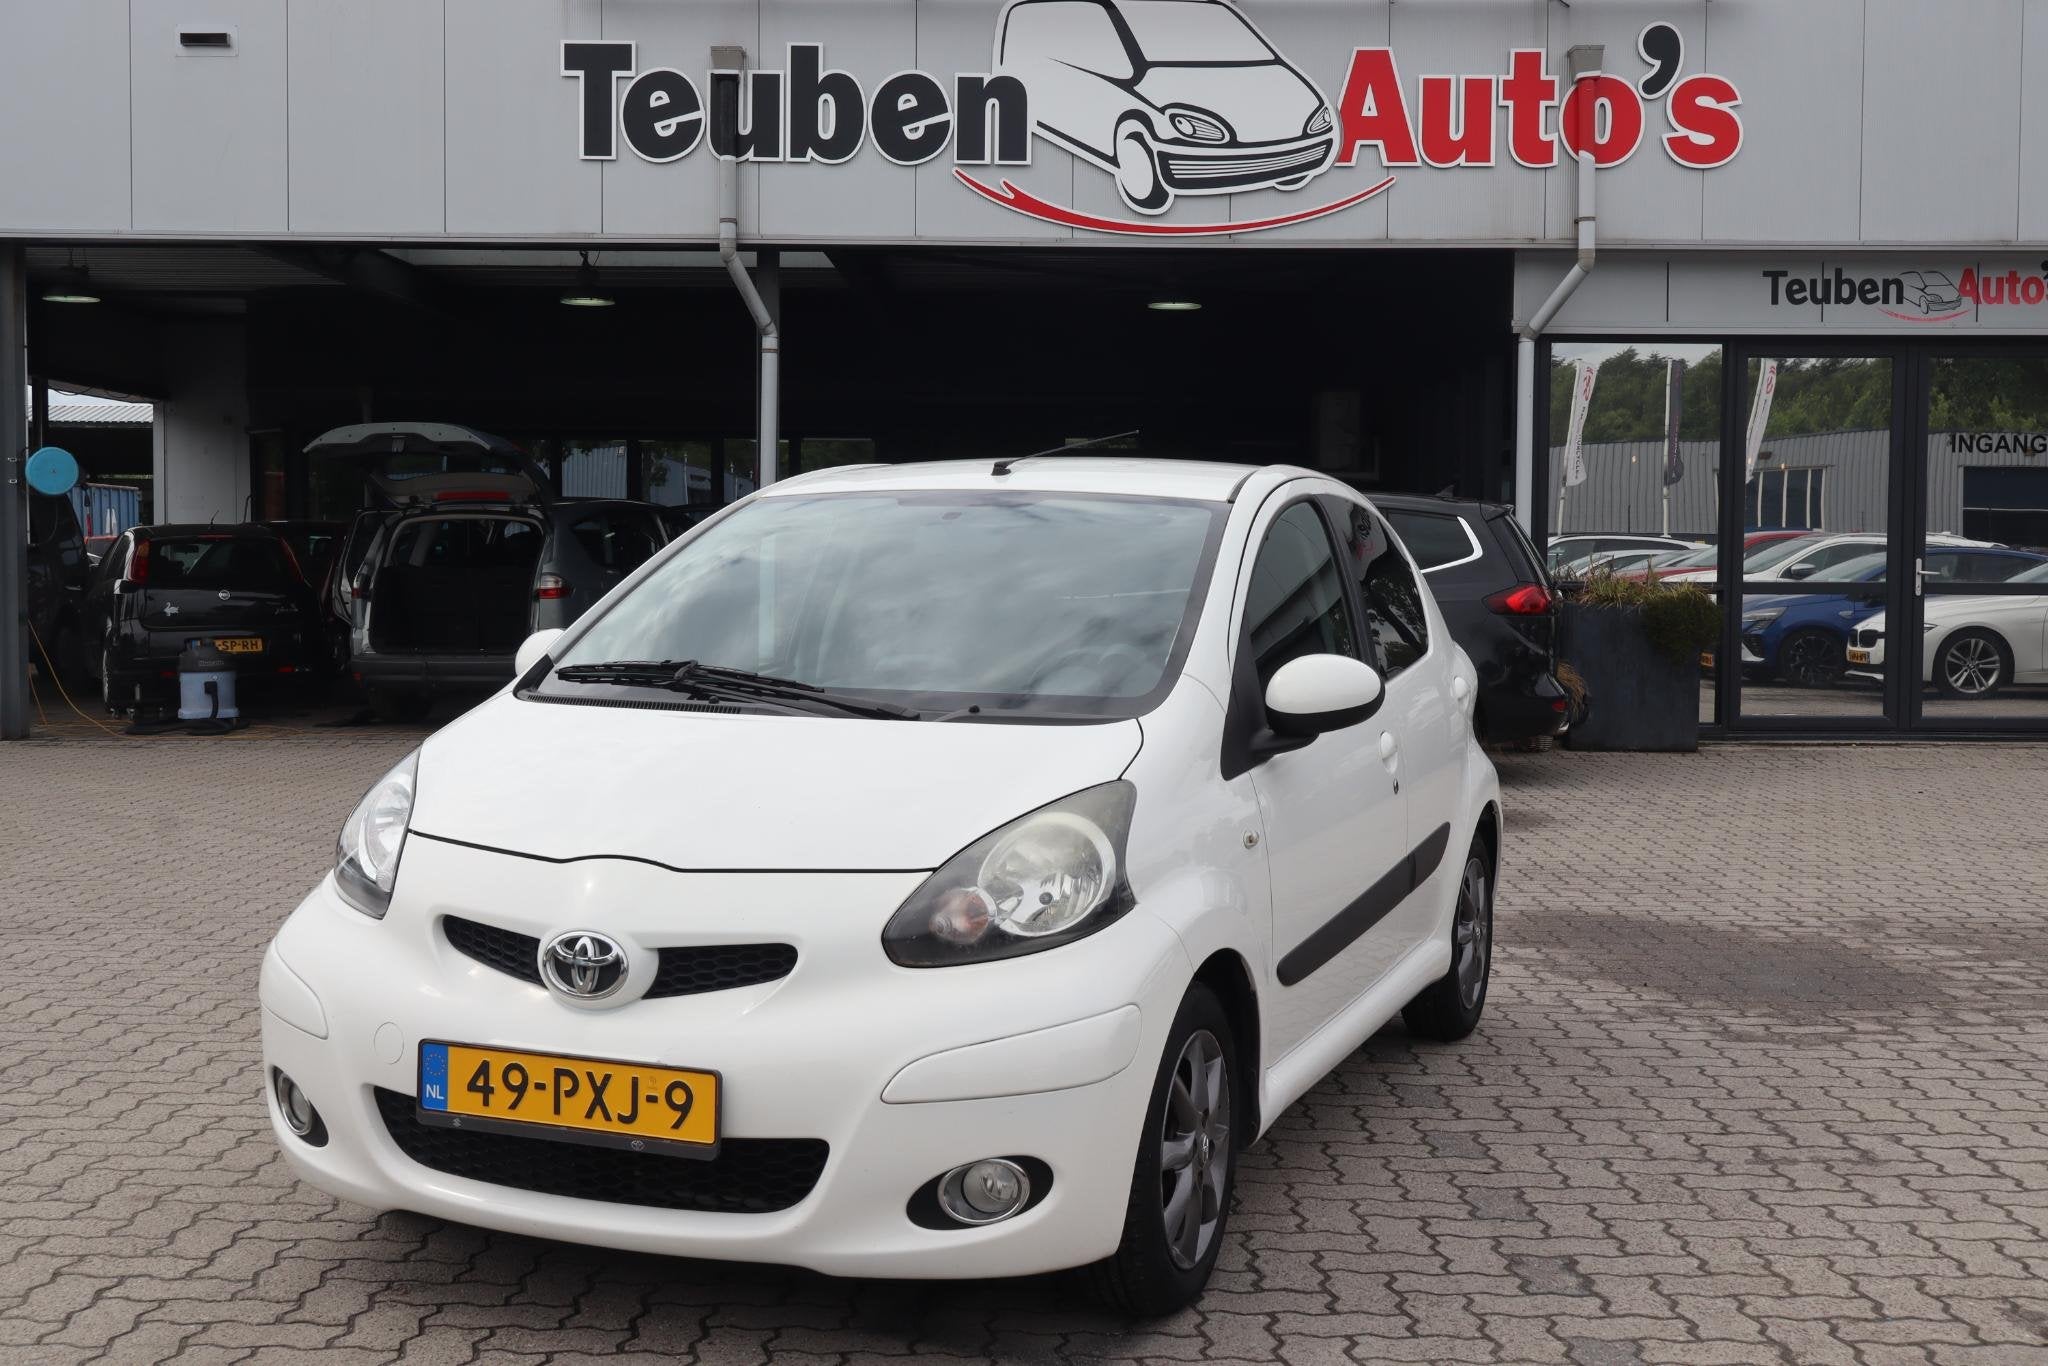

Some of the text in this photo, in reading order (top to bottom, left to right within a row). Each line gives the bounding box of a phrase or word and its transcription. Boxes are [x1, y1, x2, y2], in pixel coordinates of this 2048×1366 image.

[562, 22, 1742, 168] Teuben Auto's
[1762, 260, 2048, 305] Teuben Auto'
[1951, 434, 2047, 453] INGANG
[426, 1084, 444, 1100] NL
[466, 1059, 694, 1130] 49-PXJ-9
